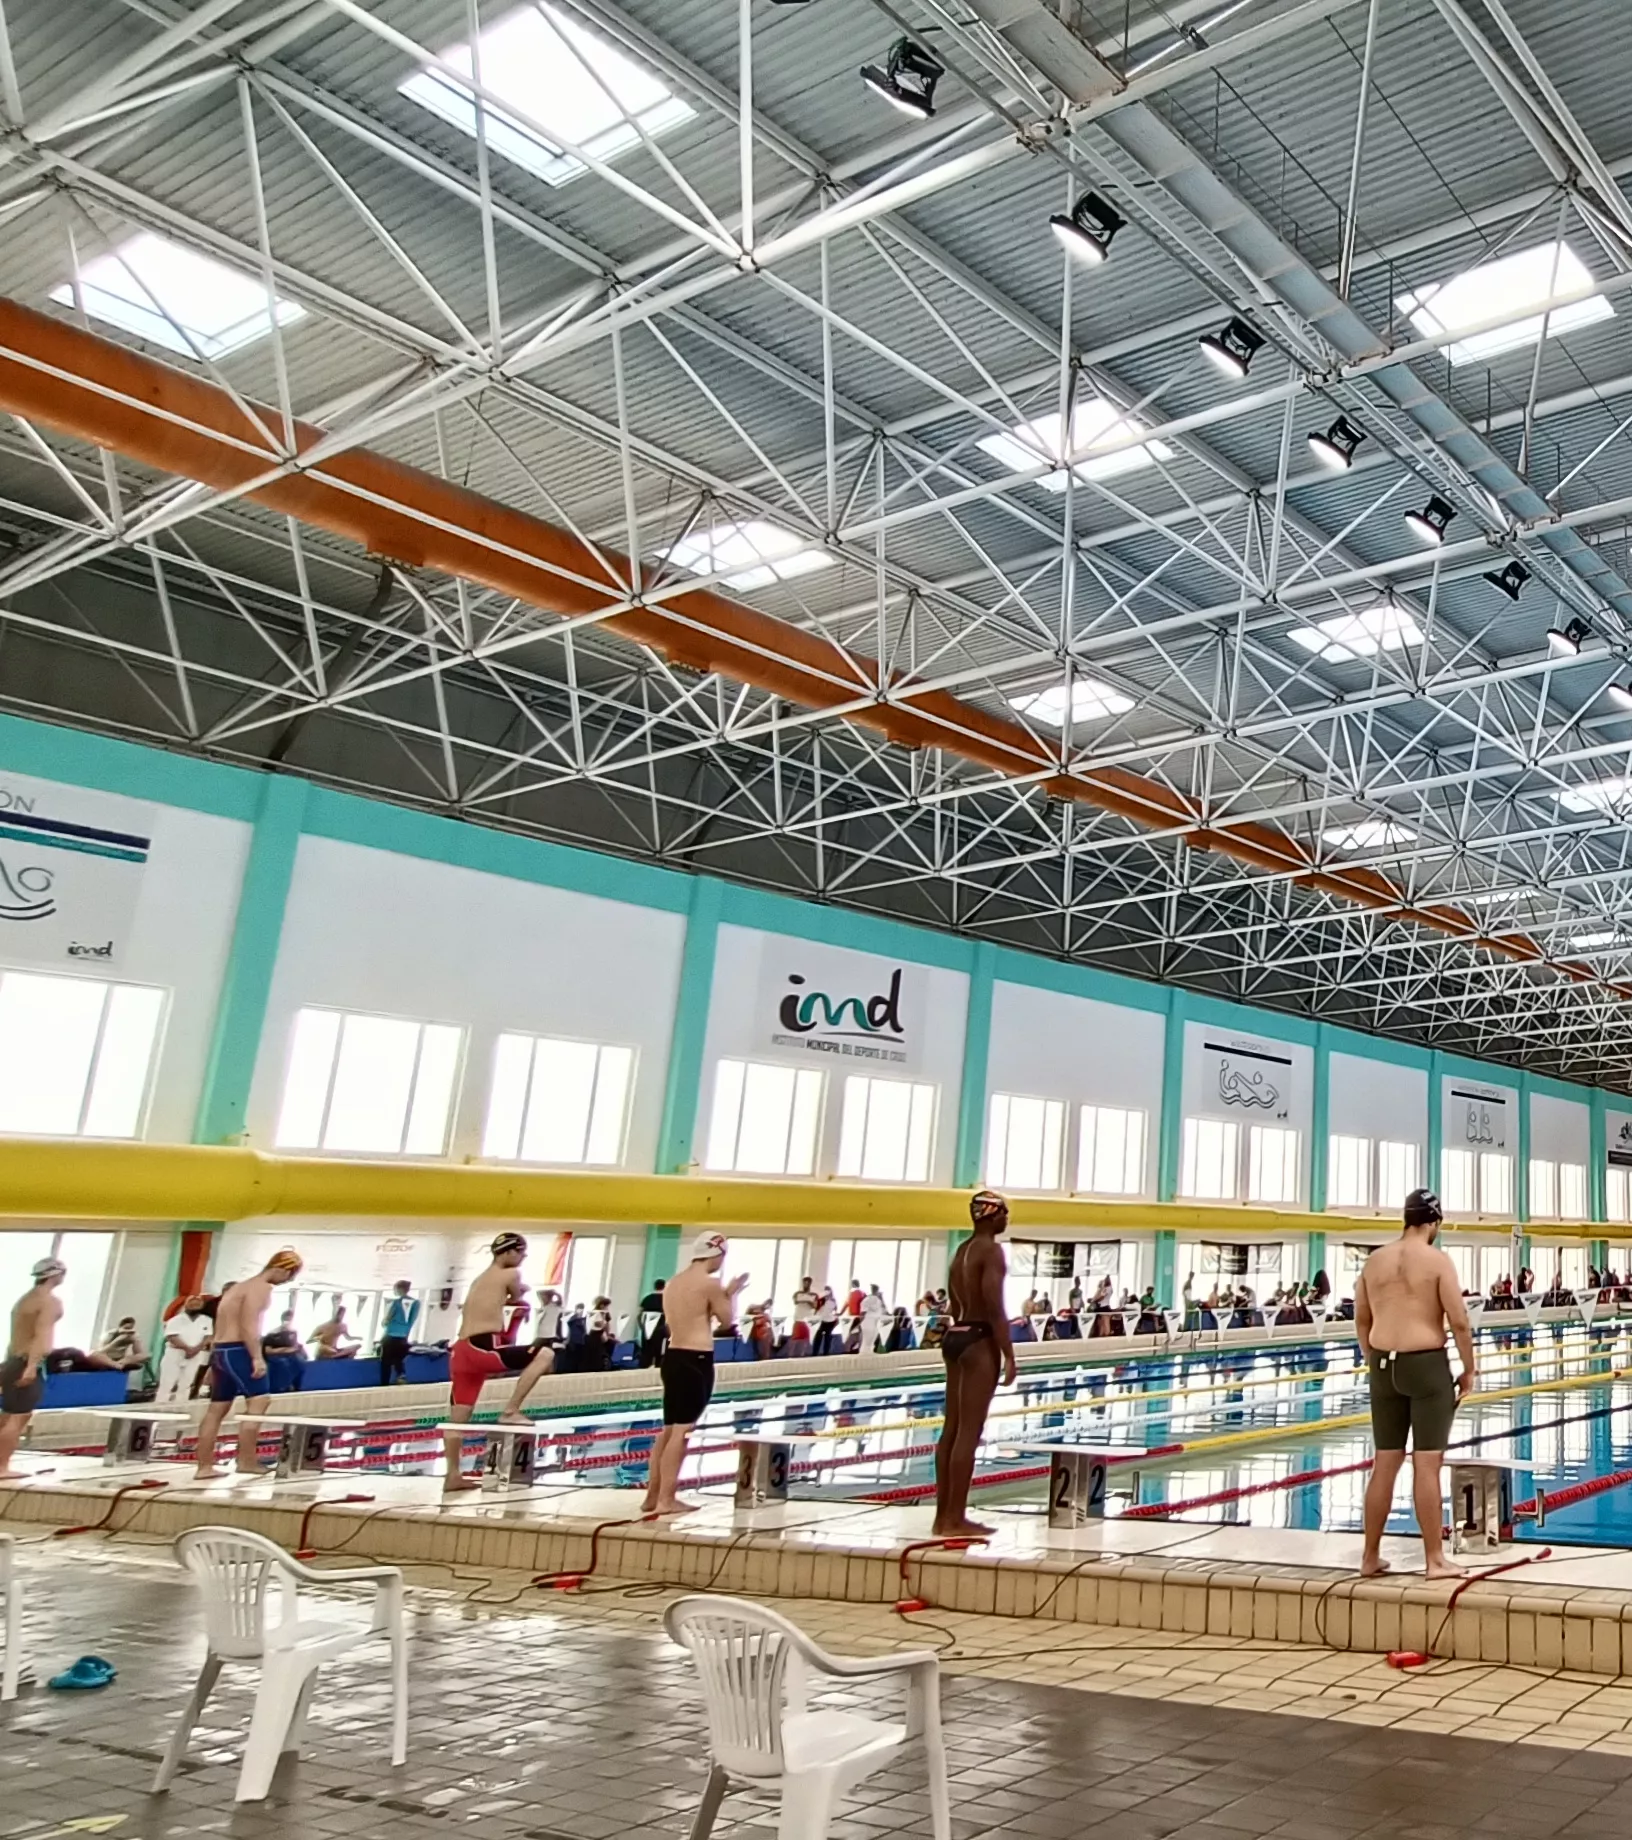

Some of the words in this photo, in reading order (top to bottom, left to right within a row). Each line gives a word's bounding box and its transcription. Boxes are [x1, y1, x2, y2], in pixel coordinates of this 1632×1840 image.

[779, 968, 905, 1033] imd
[131, 1425, 149, 1453] 6
[305, 1432, 324, 1462] 5
[487, 1441, 498, 1476] 4
[514, 1441, 530, 1474] 4
[740, 1454, 752, 1489] 3
[771, 1452, 786, 1488] 3
[1055, 1466, 1071, 1508] 2
[1089, 1464, 1104, 1506] 2
[1462, 1483, 1478, 1531] 1
